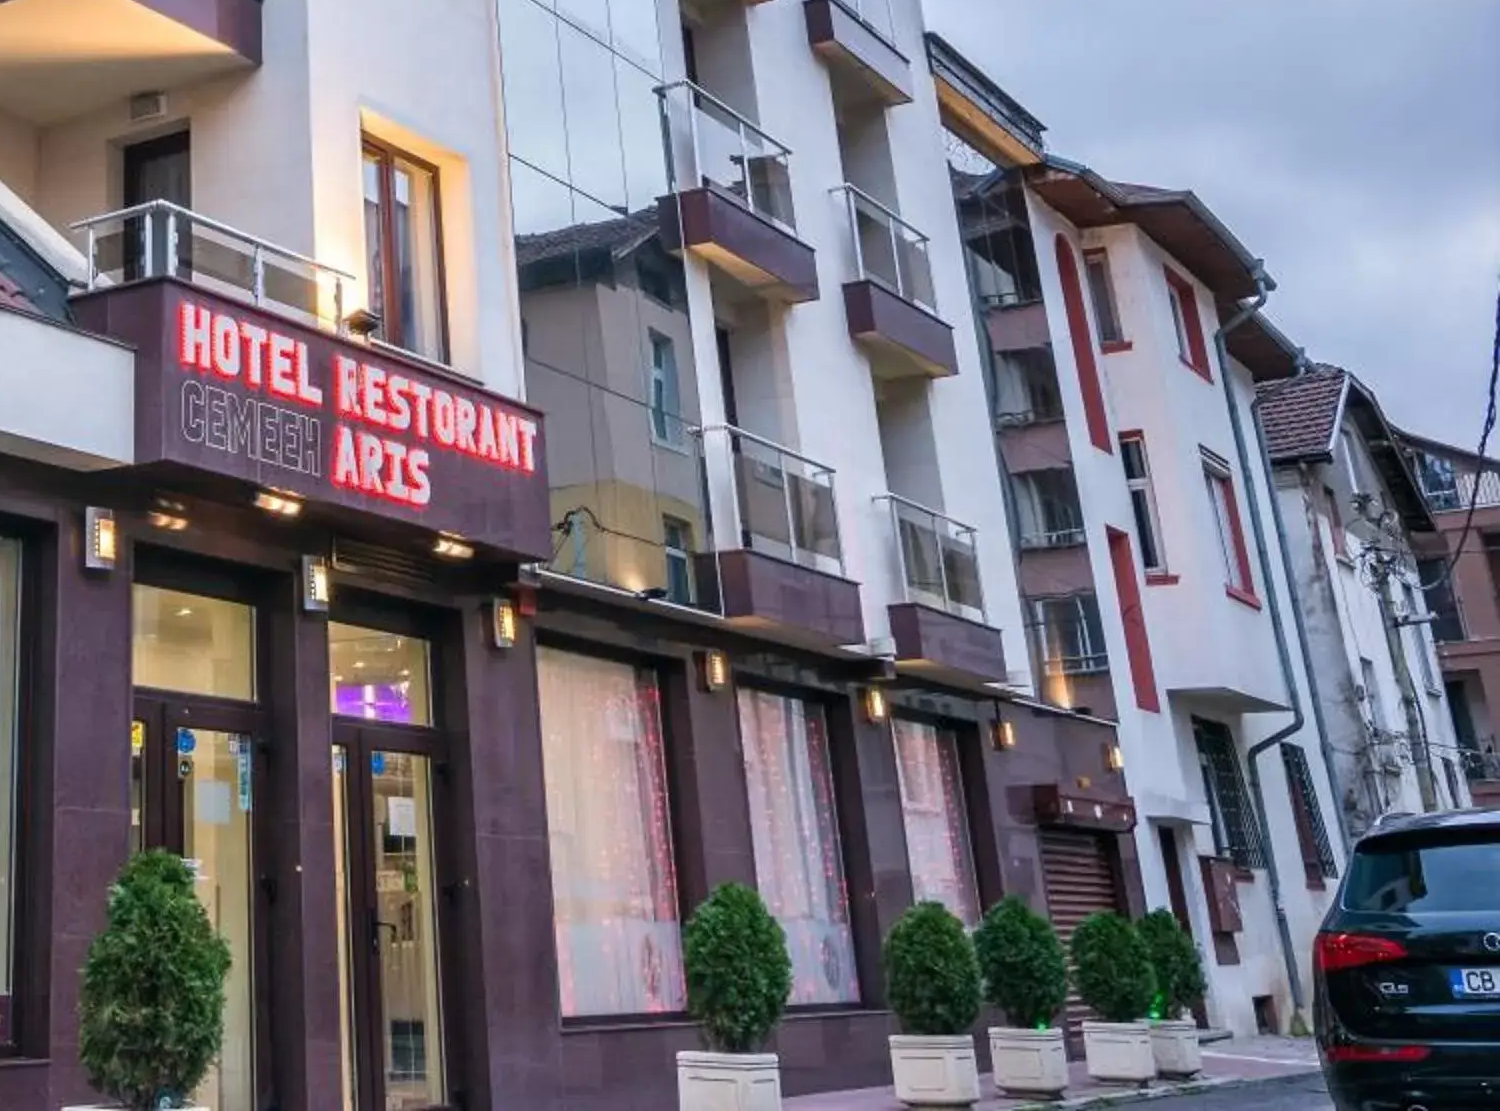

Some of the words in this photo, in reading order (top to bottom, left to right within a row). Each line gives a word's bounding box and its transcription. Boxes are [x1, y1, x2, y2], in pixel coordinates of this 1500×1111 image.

[179, 302, 323, 407] HOTEL
[333, 353, 538, 476] RESTORANT
[331, 424, 431, 506] ARIS
